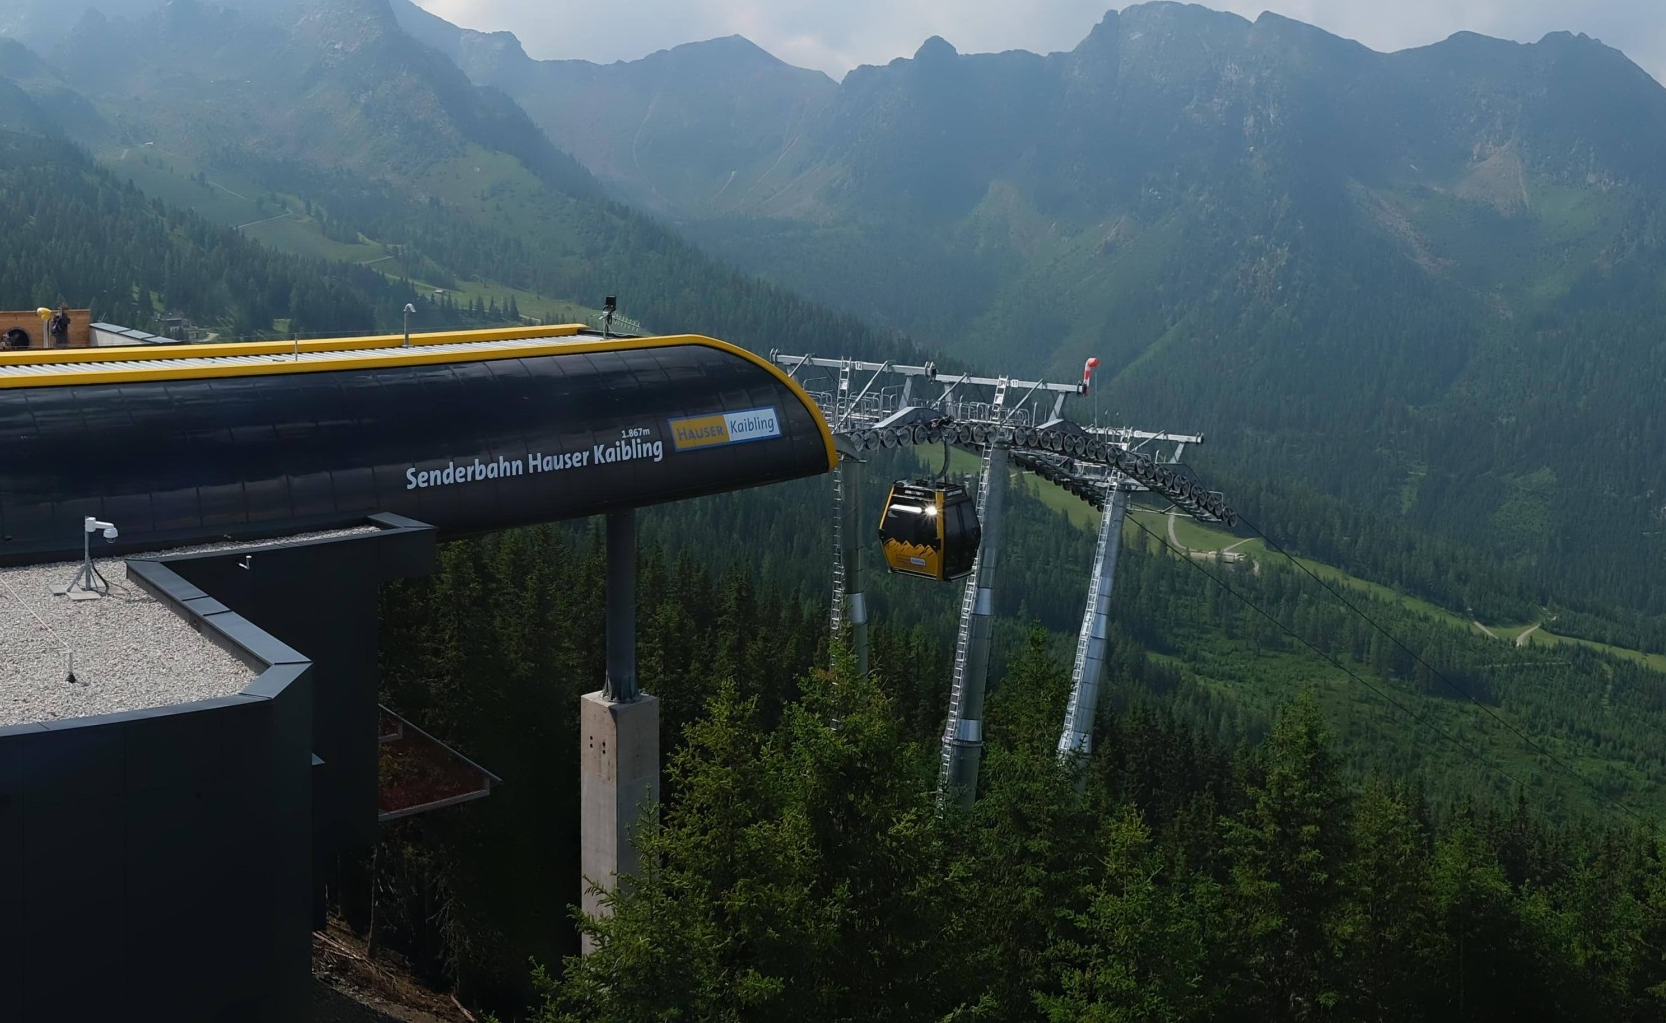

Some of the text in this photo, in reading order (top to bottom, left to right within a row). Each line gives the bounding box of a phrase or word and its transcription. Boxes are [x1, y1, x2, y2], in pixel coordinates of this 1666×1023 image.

[621, 427, 651, 439] 1.867m
[676, 411, 775, 442] HAUSER Kaibling
[406, 438, 664, 490] Senderbahn Hauser Kaibling
